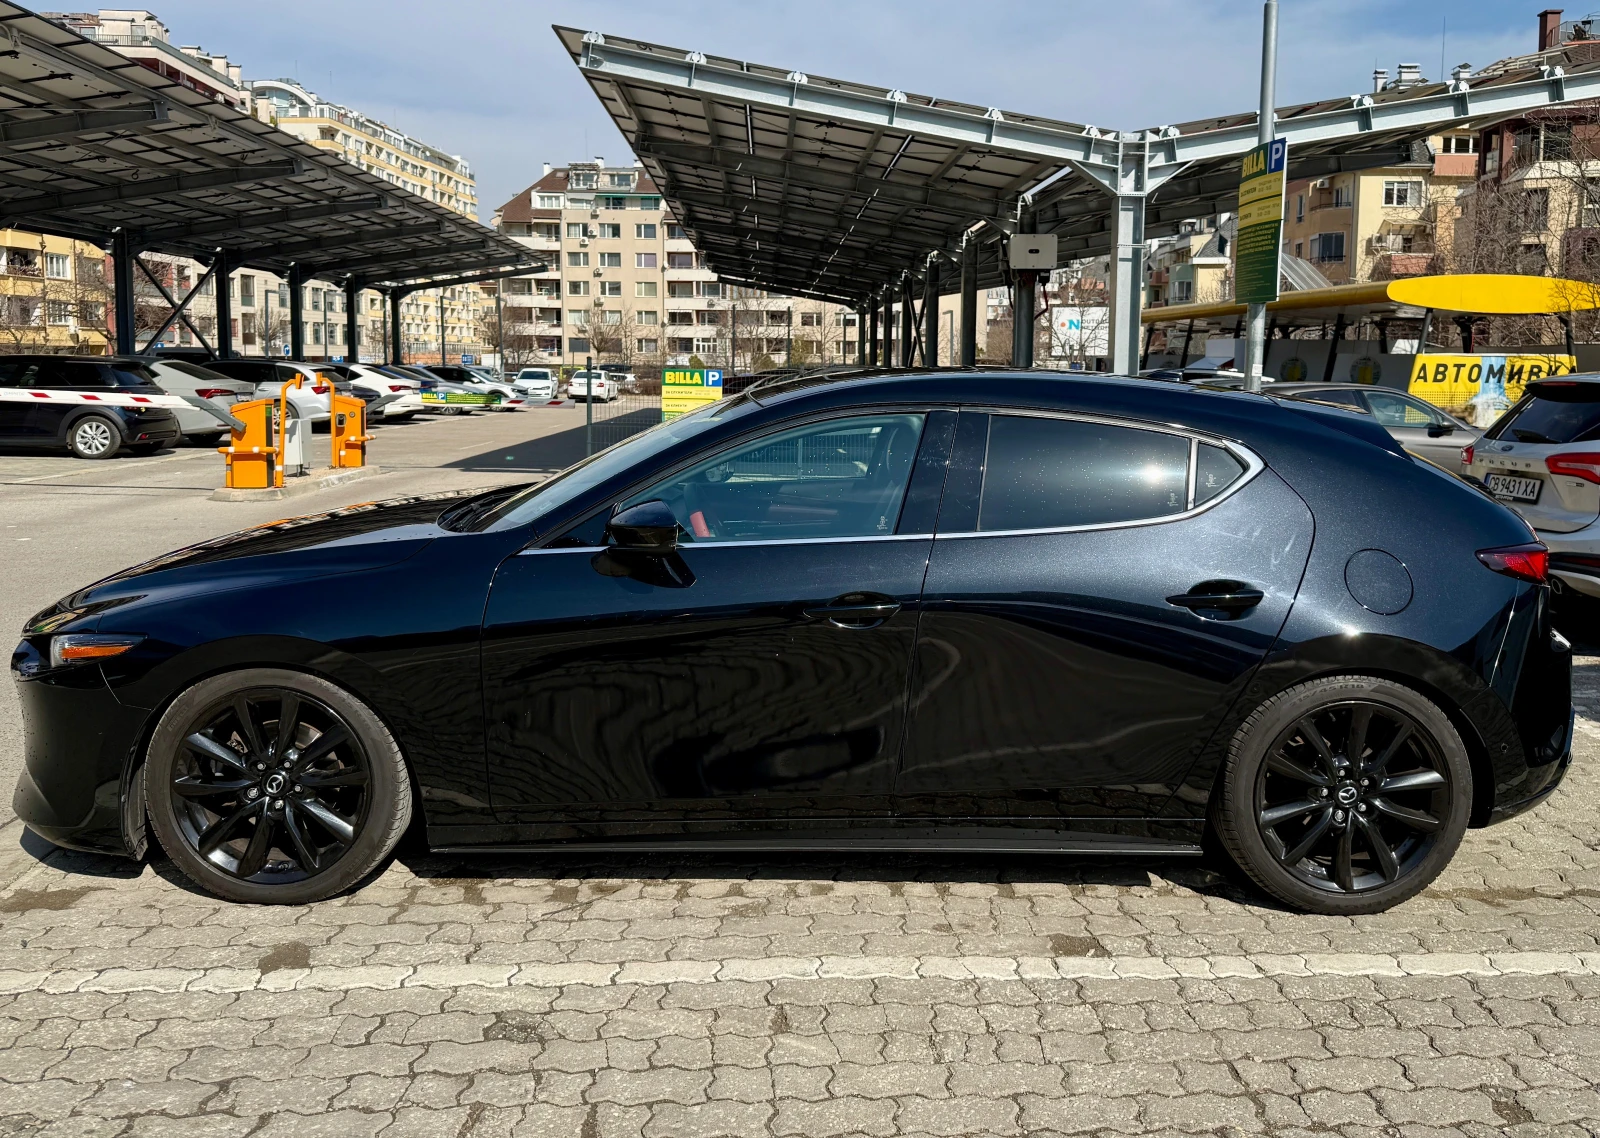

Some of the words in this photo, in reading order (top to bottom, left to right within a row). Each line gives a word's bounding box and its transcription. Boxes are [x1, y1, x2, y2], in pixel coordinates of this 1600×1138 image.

[1242, 150, 1265, 178] BILLA
[1270, 142, 1283, 170] P
[665, 372, 702, 384] BILLA
[708, 371, 720, 386] P
[1500, 478, 1522, 495] 9431
